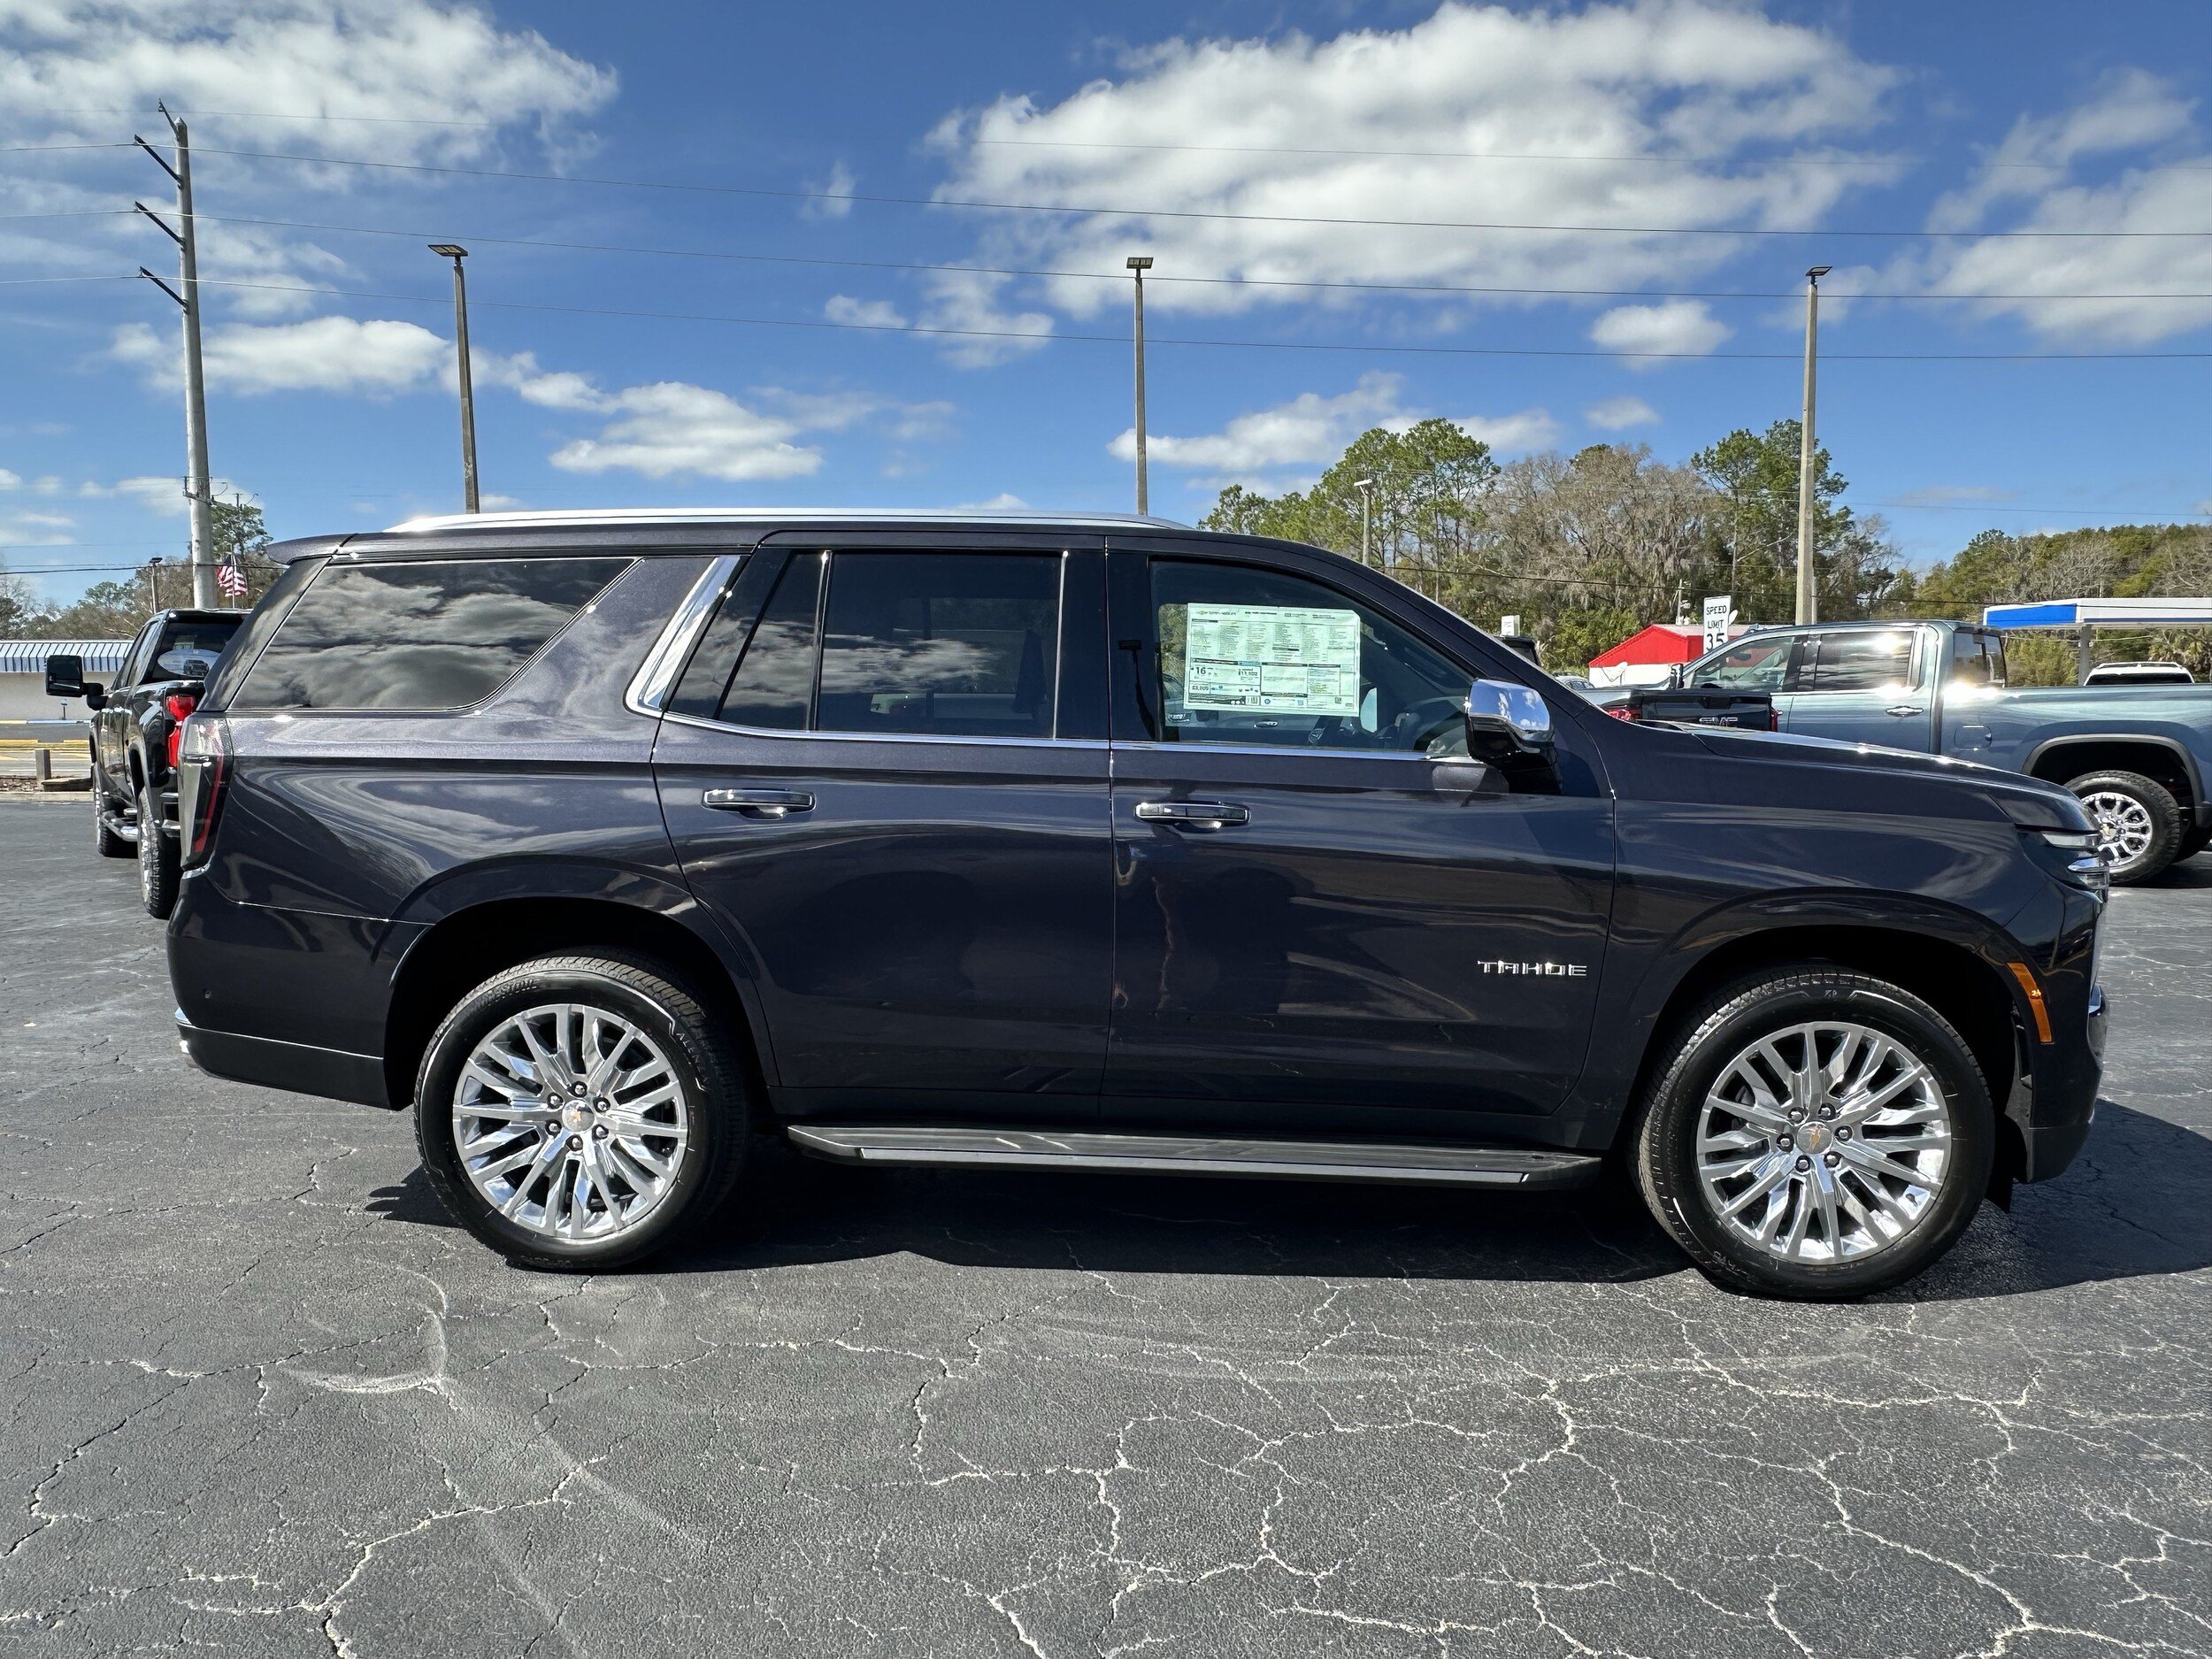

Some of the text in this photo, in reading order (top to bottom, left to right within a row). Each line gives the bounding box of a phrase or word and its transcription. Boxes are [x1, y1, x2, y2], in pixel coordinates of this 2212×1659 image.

[1706, 605, 1727, 615] SPEED
[1708, 619, 1724, 629] LIMIT
[1706, 633, 1724, 651] 35
[1195, 666, 1206, 675] 16
[1477, 960, 1587, 976] TAHOE
